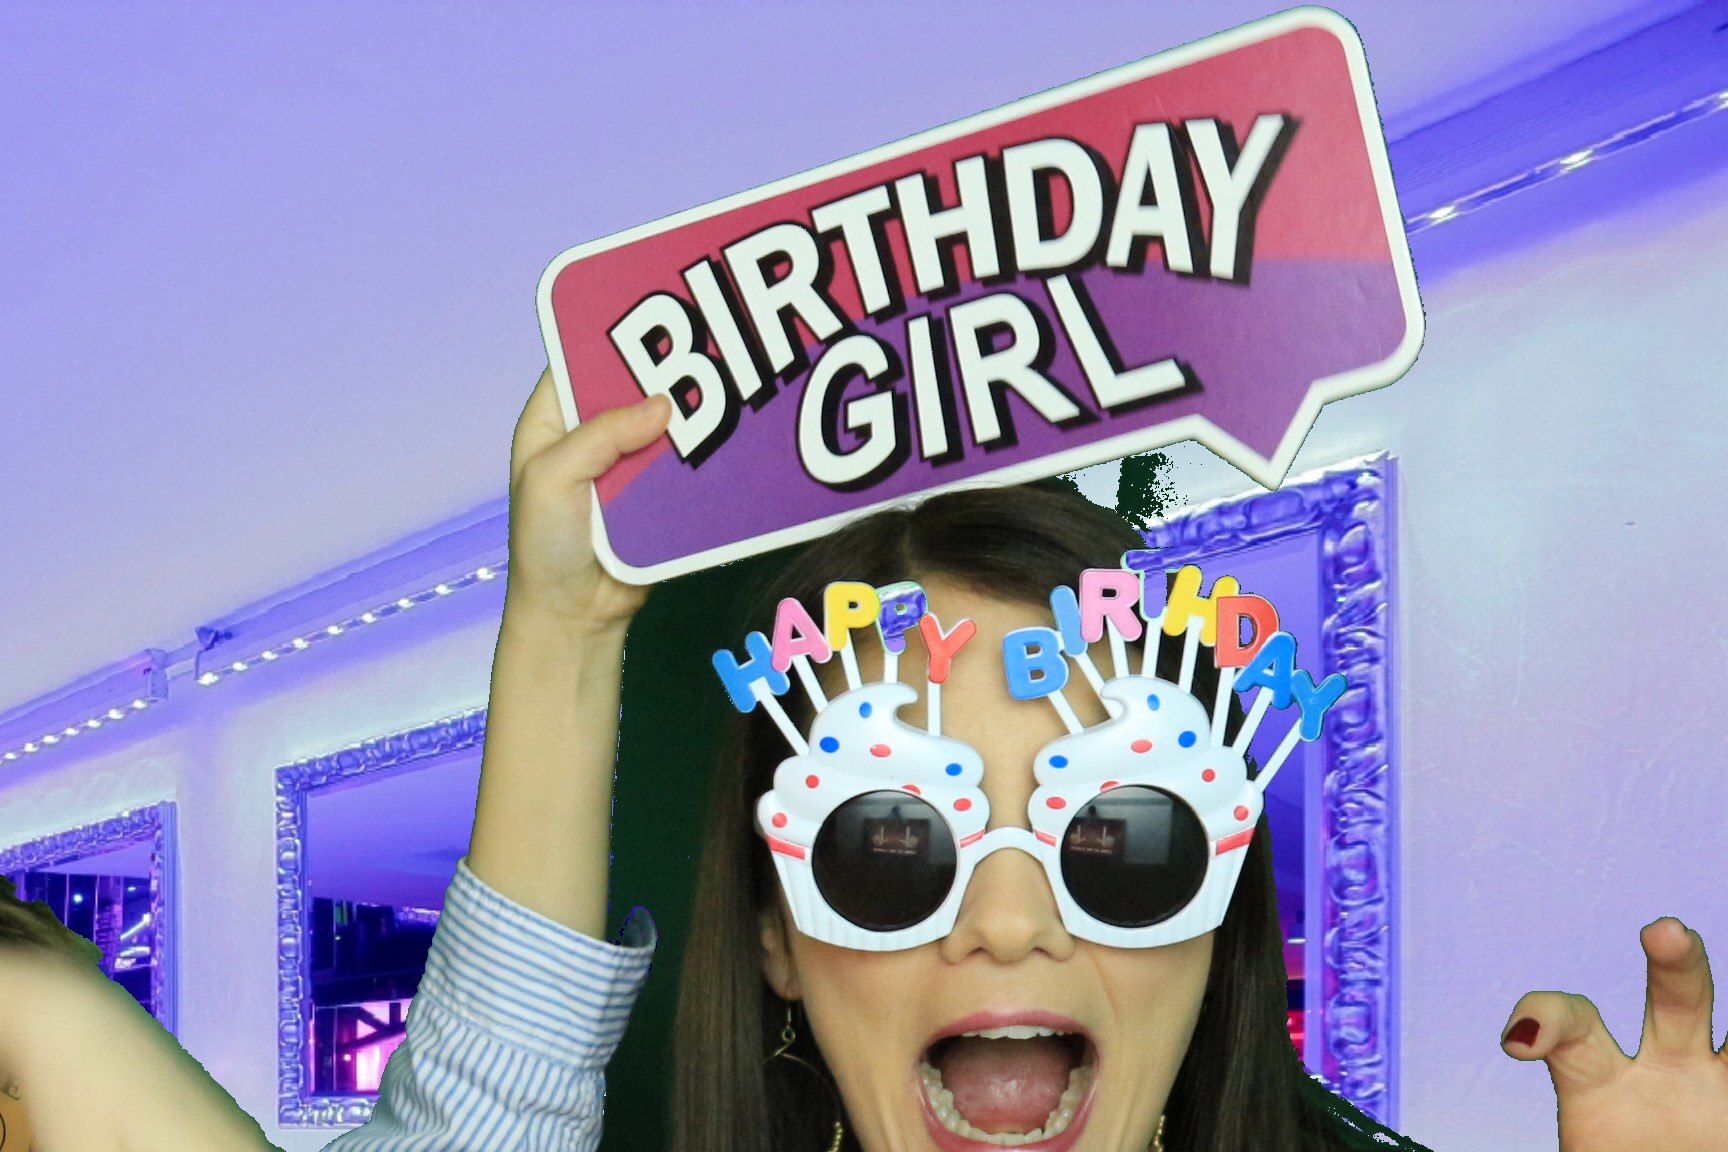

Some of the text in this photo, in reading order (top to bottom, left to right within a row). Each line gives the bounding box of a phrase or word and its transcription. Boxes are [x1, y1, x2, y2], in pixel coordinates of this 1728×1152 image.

[609, 113, 1300, 464] BIRTHDAY
[795, 273, 1203, 487] GIRL
[711, 548, 1348, 741] HAPPY BIRTHDAY
